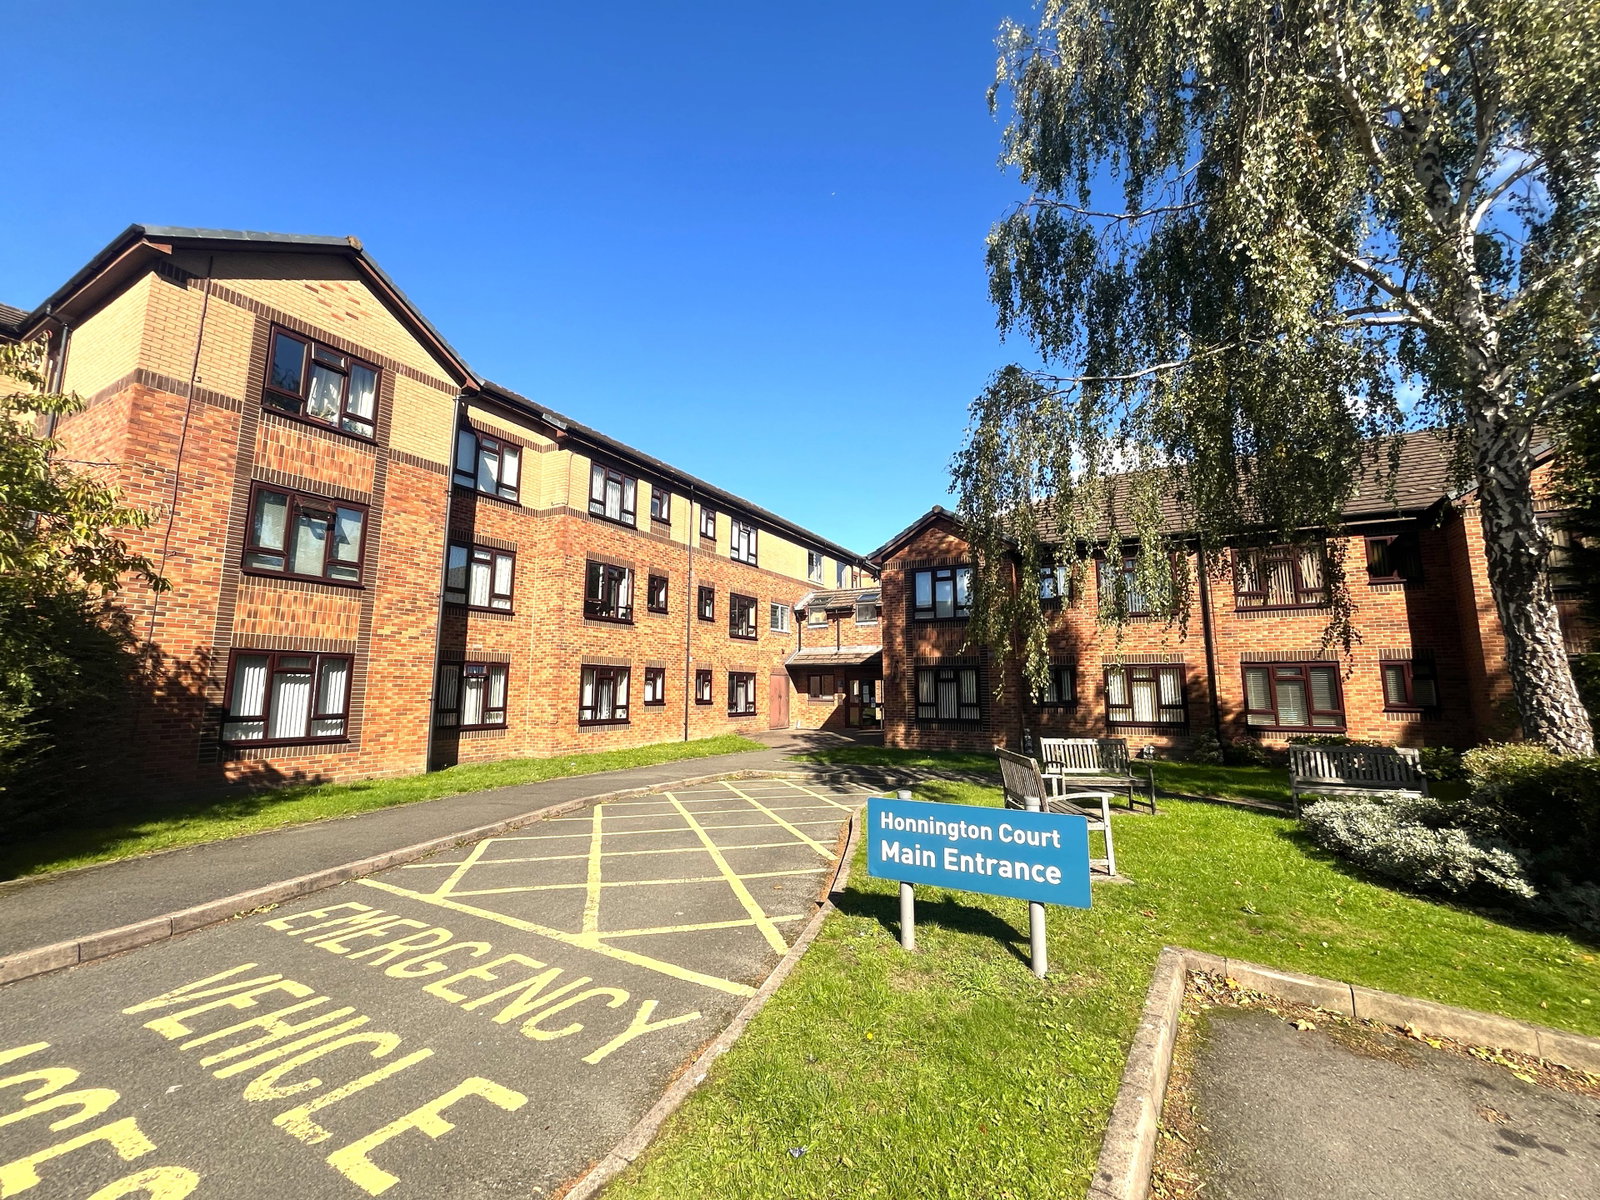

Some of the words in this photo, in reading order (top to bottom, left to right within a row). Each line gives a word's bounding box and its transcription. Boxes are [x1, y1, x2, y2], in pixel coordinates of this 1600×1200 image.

[880, 811, 993, 842] Honnington
[998, 823, 1061, 848] Court
[880, 840, 936, 868] Main
[943, 847, 1063, 885] Entrance
[262, 901, 702, 1064] EMERGENCY
[121, 962, 528, 1196] VEHICLE
